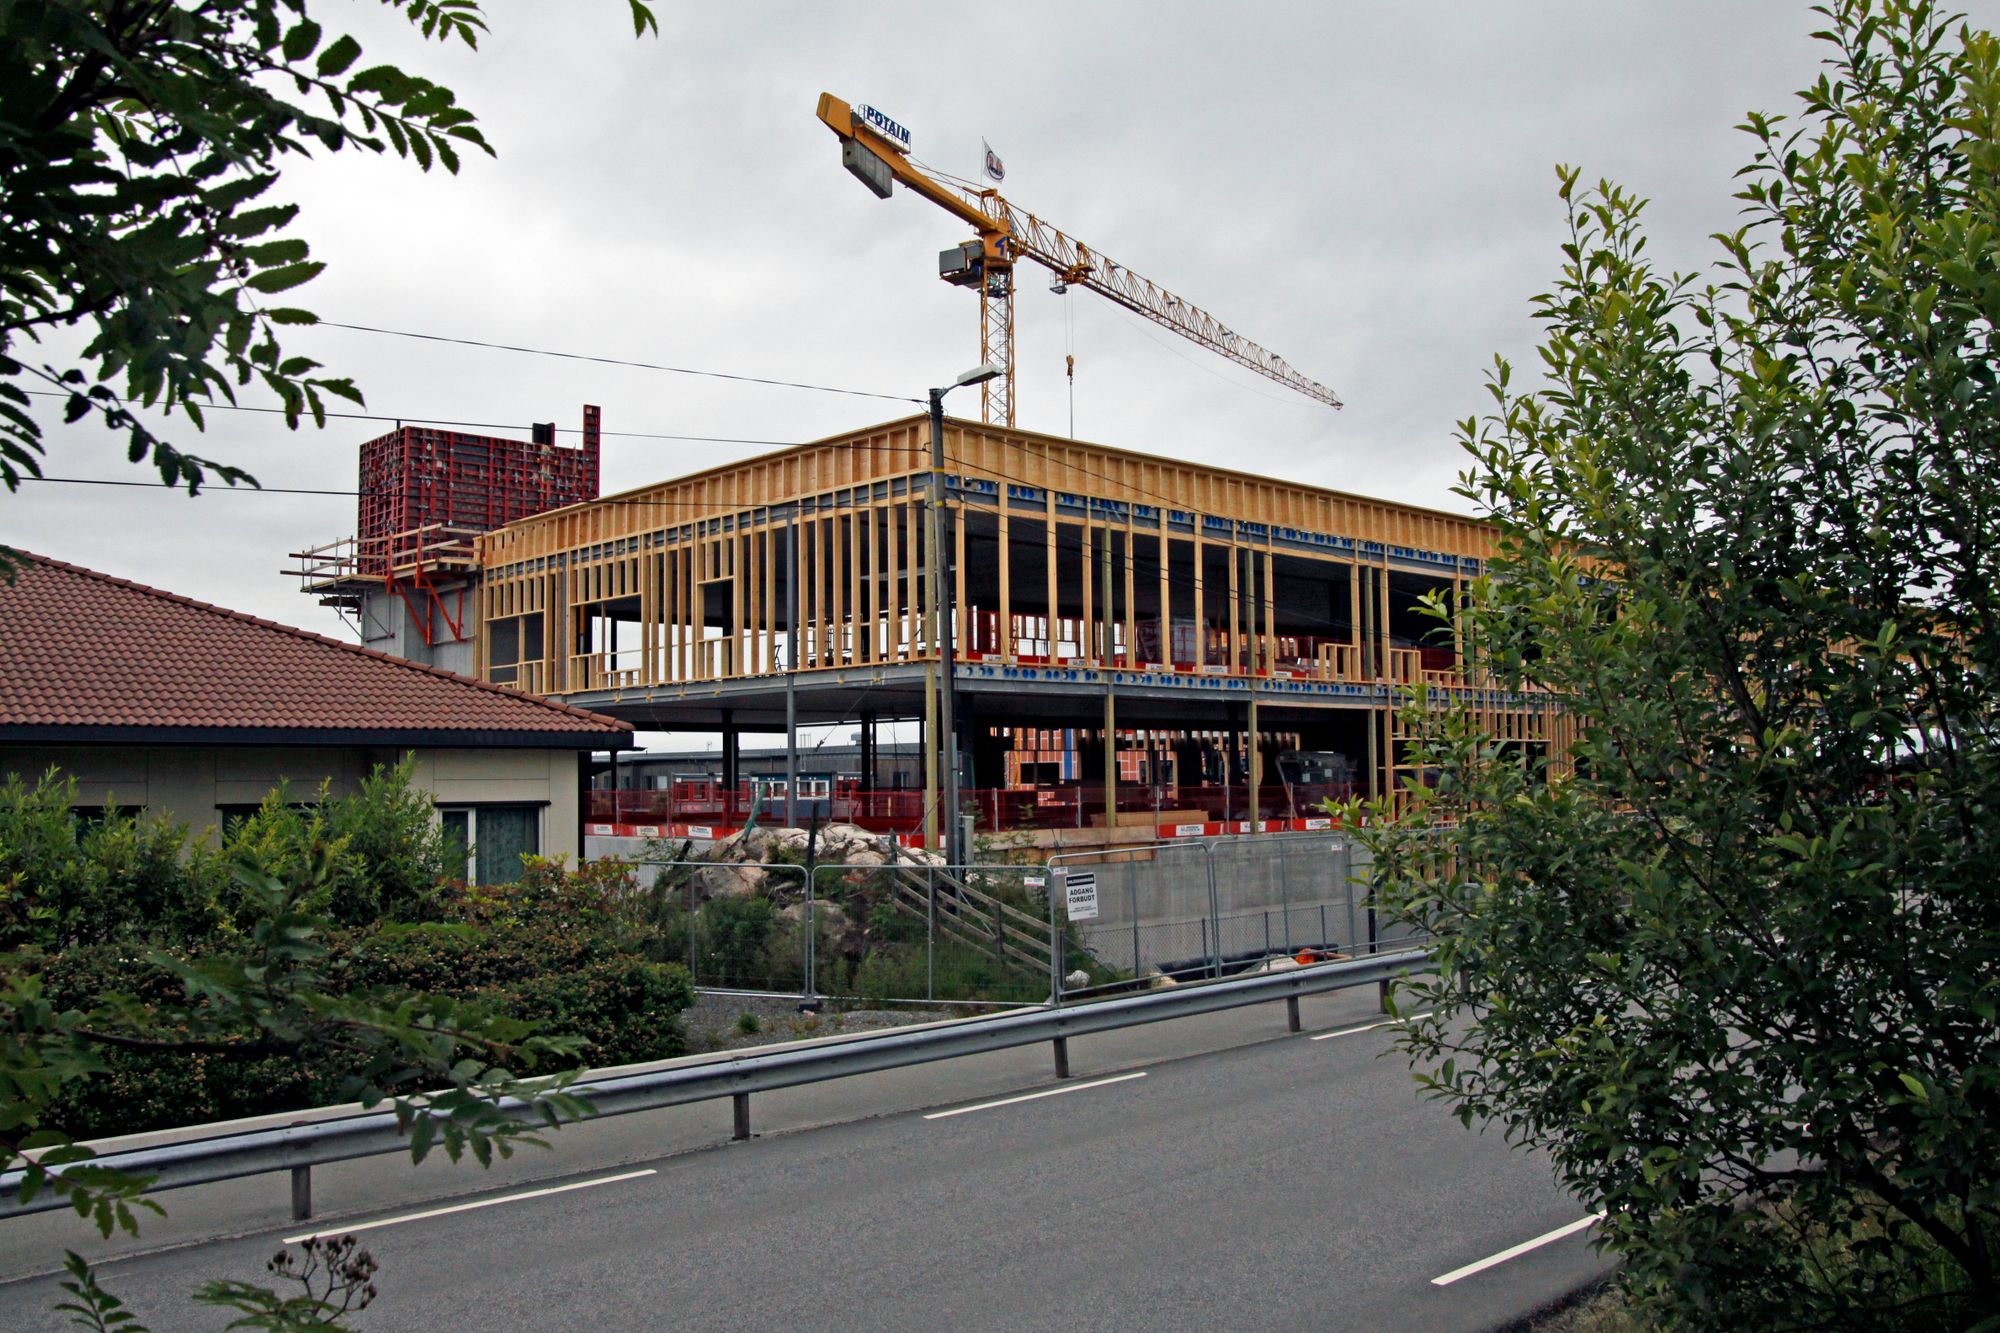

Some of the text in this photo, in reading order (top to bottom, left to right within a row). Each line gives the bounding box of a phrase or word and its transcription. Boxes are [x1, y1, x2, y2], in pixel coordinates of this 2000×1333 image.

[867, 105, 910, 143] POTAIN
[1070, 887, 1094, 896] ADGANG
[1069, 895, 1095, 903] FORBUDT
